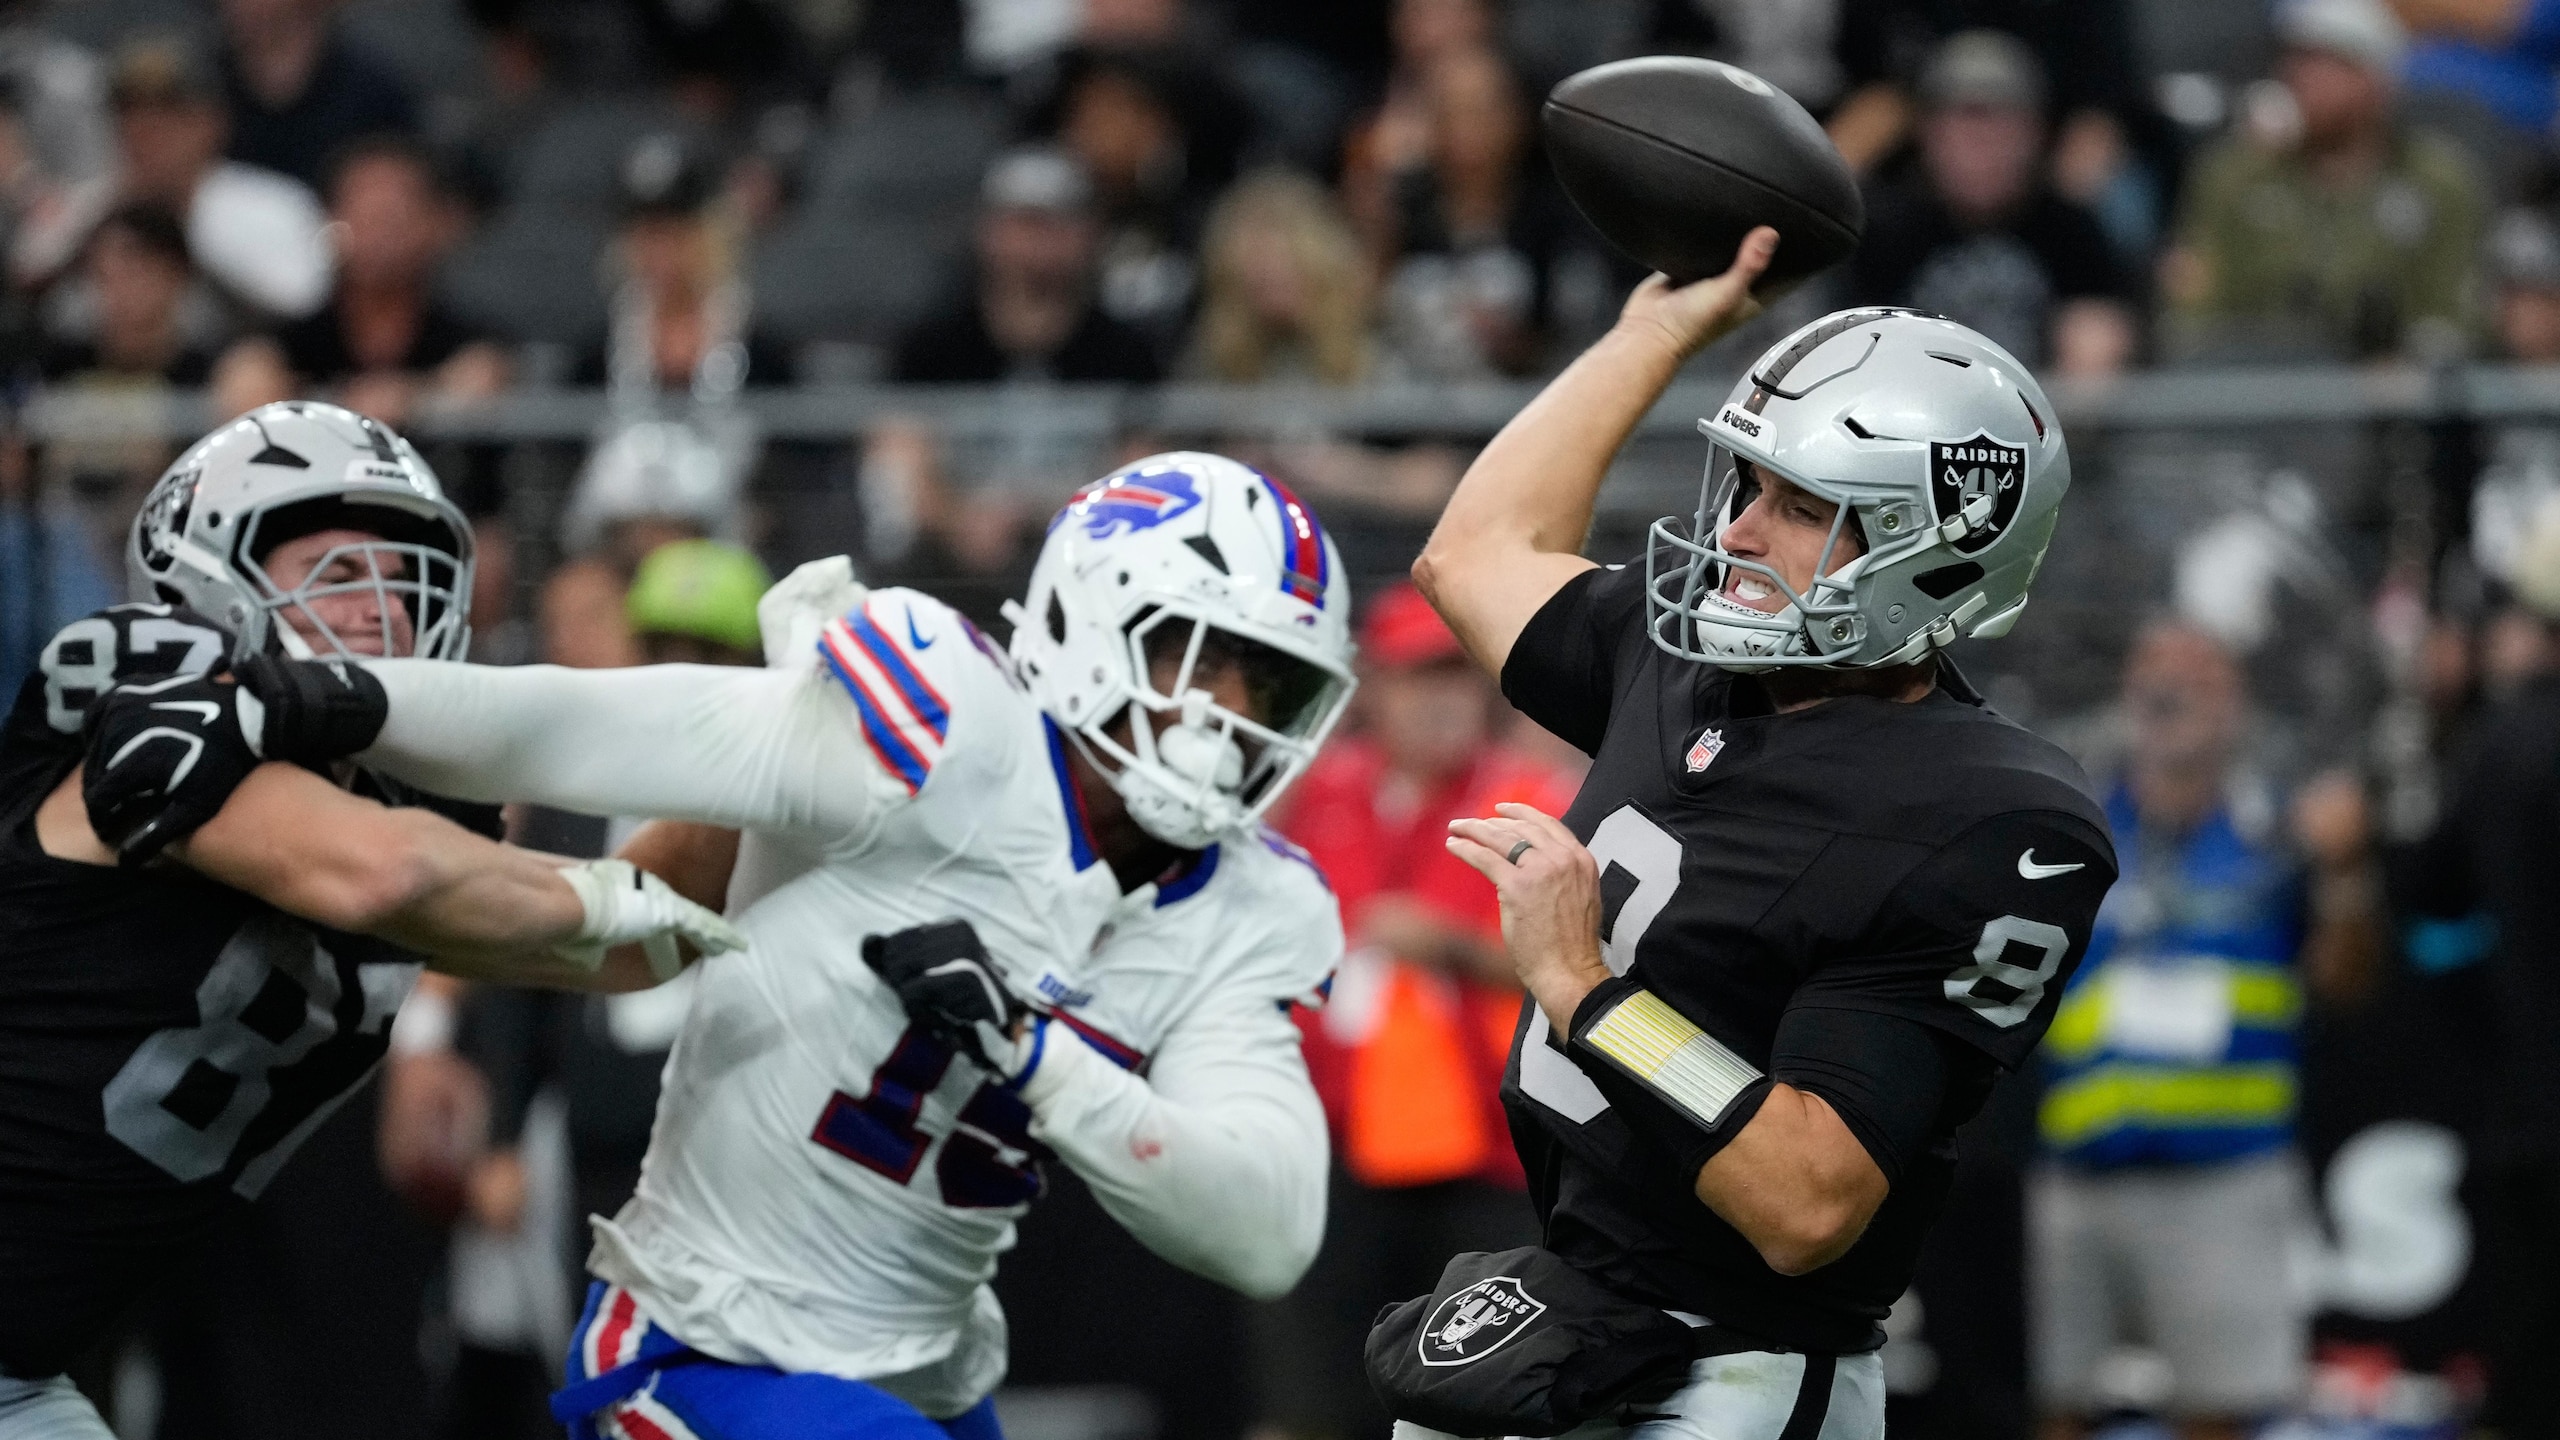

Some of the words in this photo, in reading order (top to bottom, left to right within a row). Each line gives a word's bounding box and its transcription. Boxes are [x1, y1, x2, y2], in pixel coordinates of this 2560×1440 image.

[1941, 446, 2019, 465] RAIDERS
[39, 617, 224, 734] 87
[1690, 745, 1711, 767] NFL
[1942, 914, 2070, 1029] 8
[1472, 1282, 1531, 1315] AIDERS
